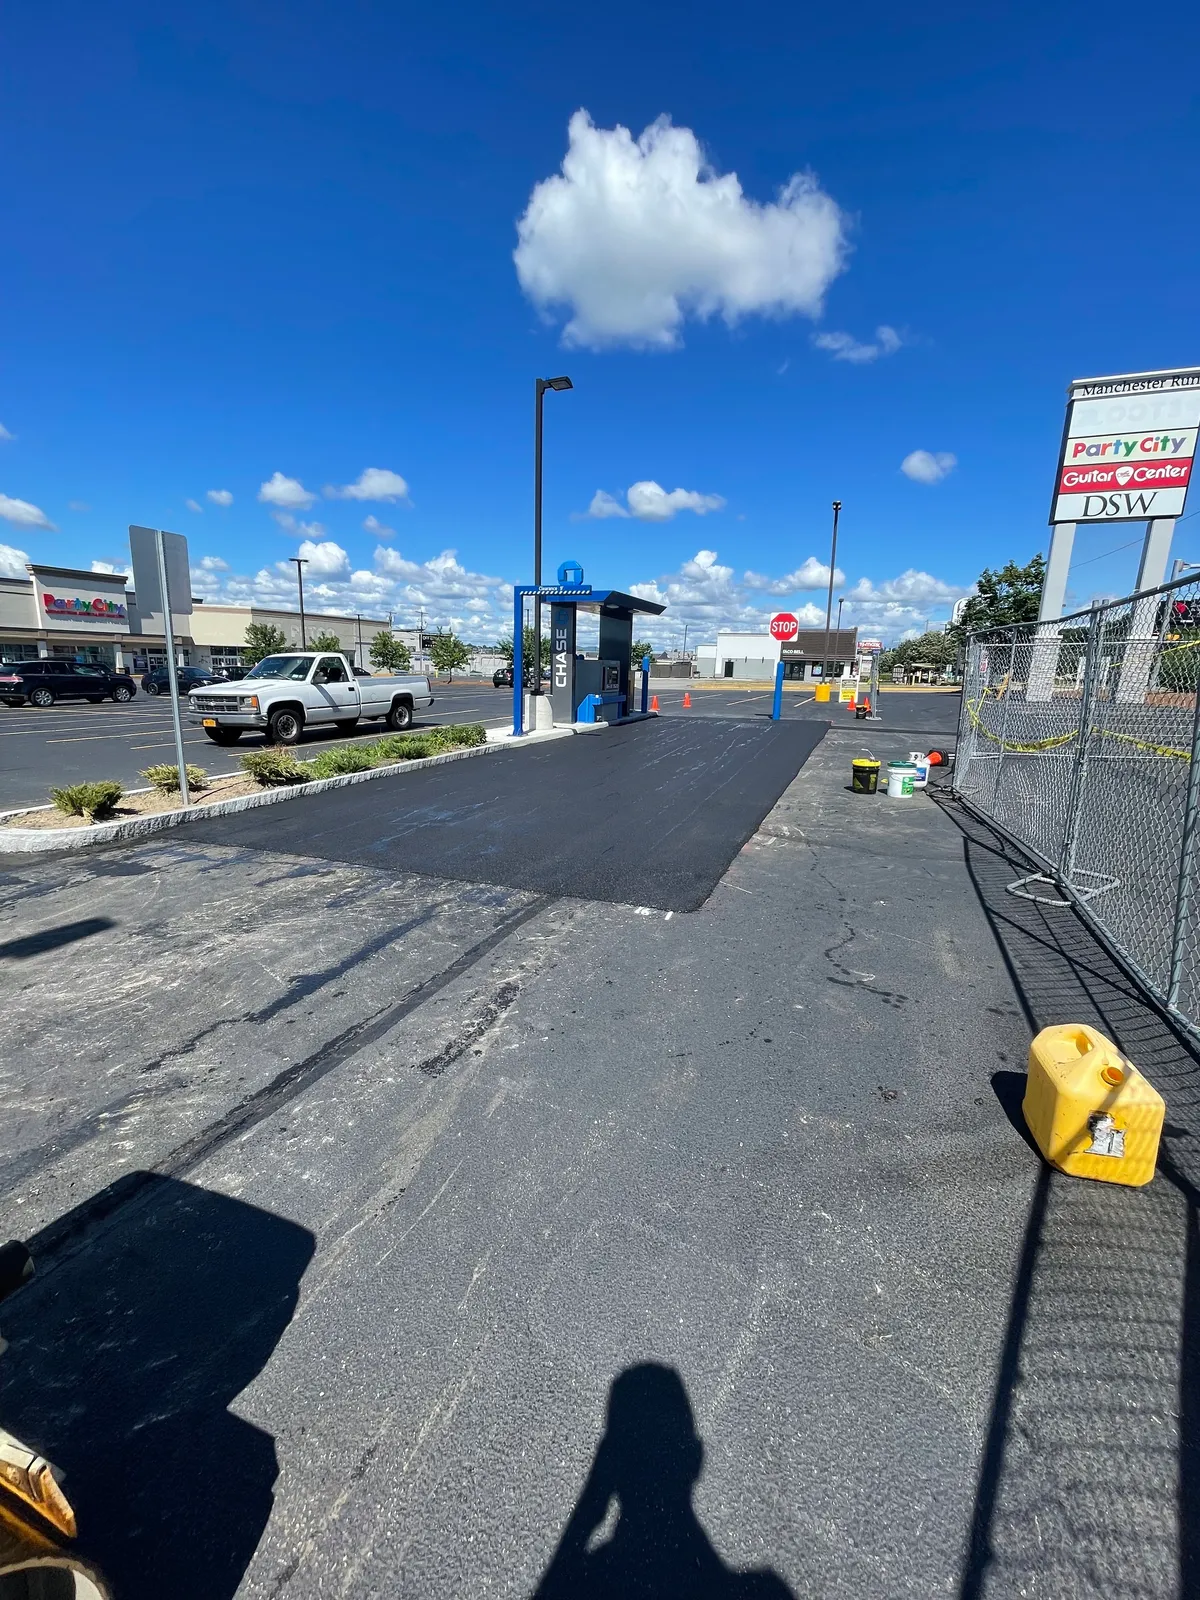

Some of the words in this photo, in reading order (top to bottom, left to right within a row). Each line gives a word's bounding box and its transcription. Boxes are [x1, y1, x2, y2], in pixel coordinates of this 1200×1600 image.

[1082, 379, 1165, 396] Manchester
[1072, 439, 1139, 458] Party
[1140, 435, 1187, 453] City
[1063, 469, 1115, 487] Guitar
[1133, 464, 1188, 482] Center
[1080, 491, 1159, 517] DSW
[43, 593, 91, 612] Party
[92, 598, 124, 614] City
[771, 621, 797, 633] STOP
[555, 628, 567, 688] CHASE
